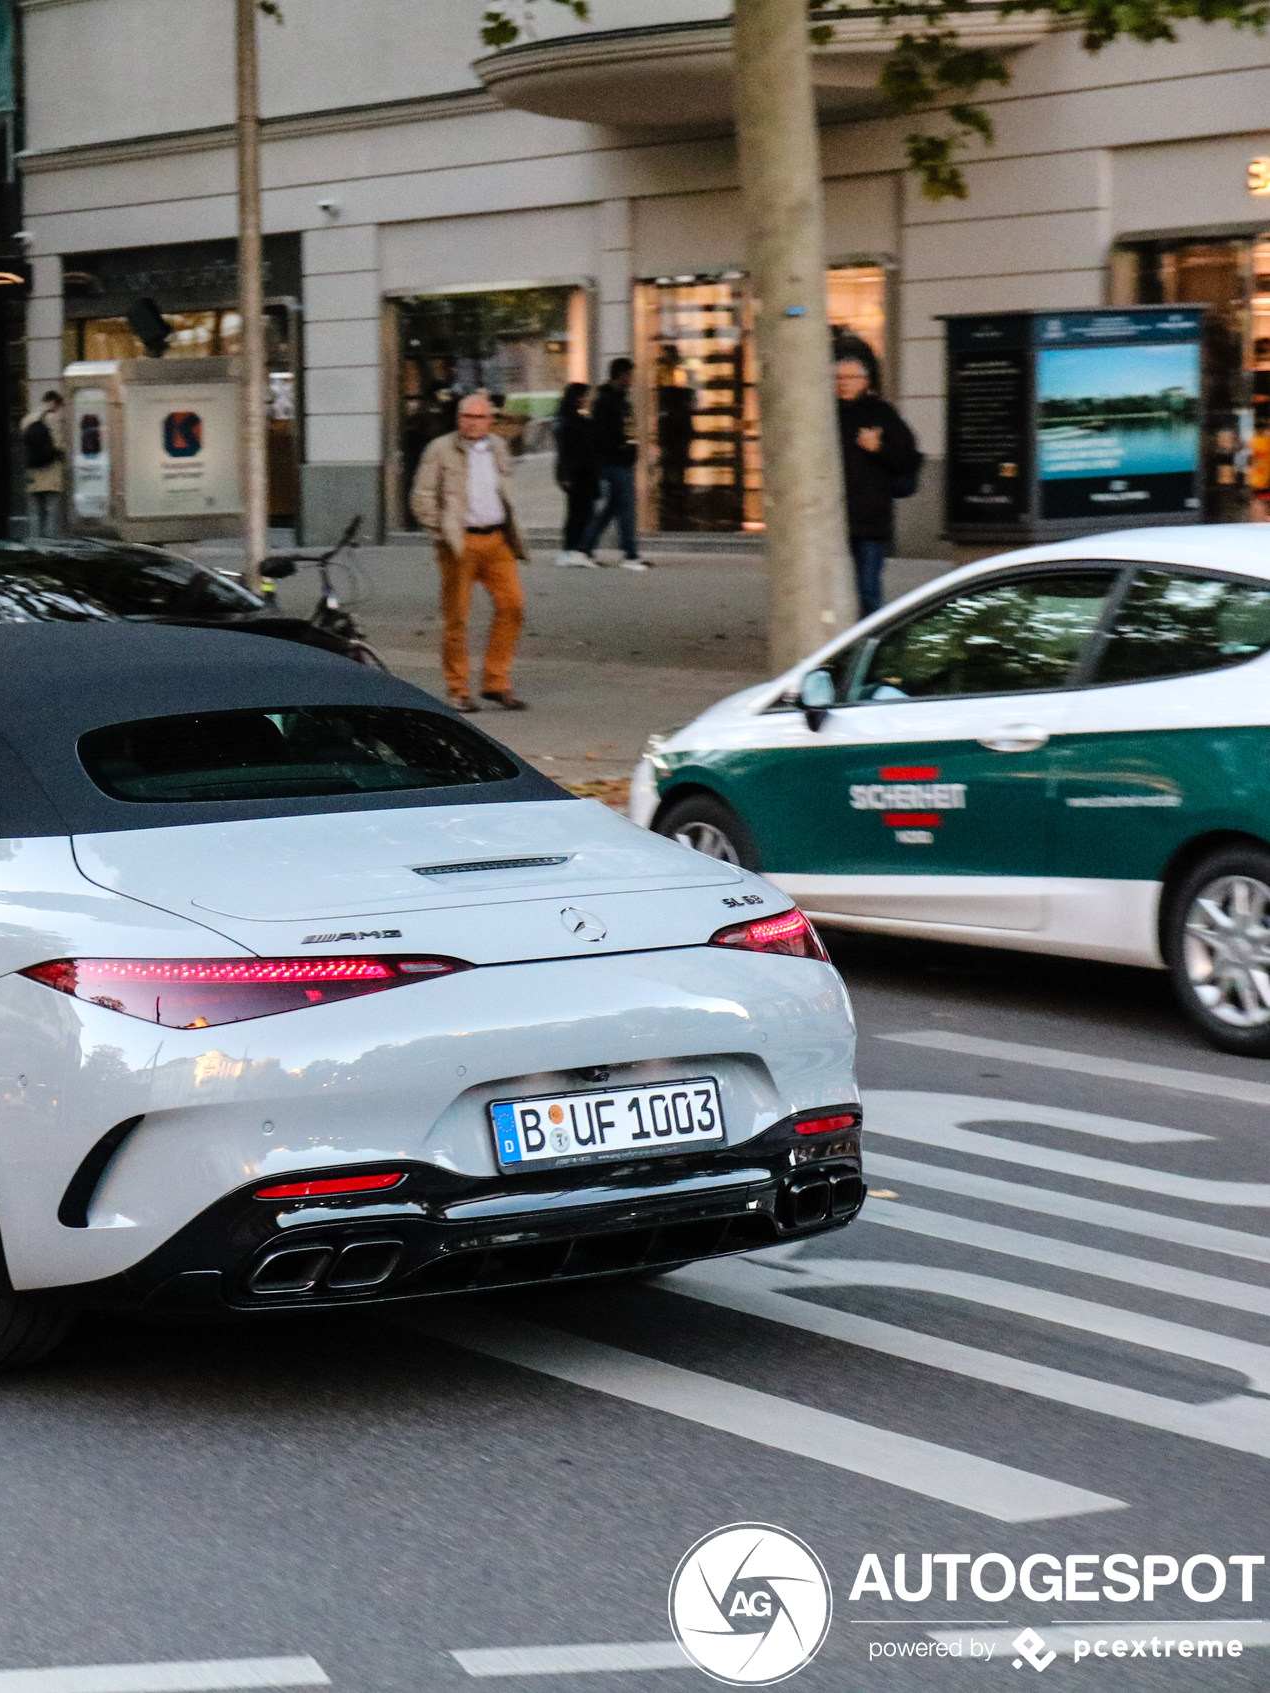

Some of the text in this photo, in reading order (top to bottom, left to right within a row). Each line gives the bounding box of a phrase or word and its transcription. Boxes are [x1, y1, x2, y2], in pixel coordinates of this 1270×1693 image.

[519, 1089, 715, 1153] B UF 1003
[505, 1140, 515, 1153] D
